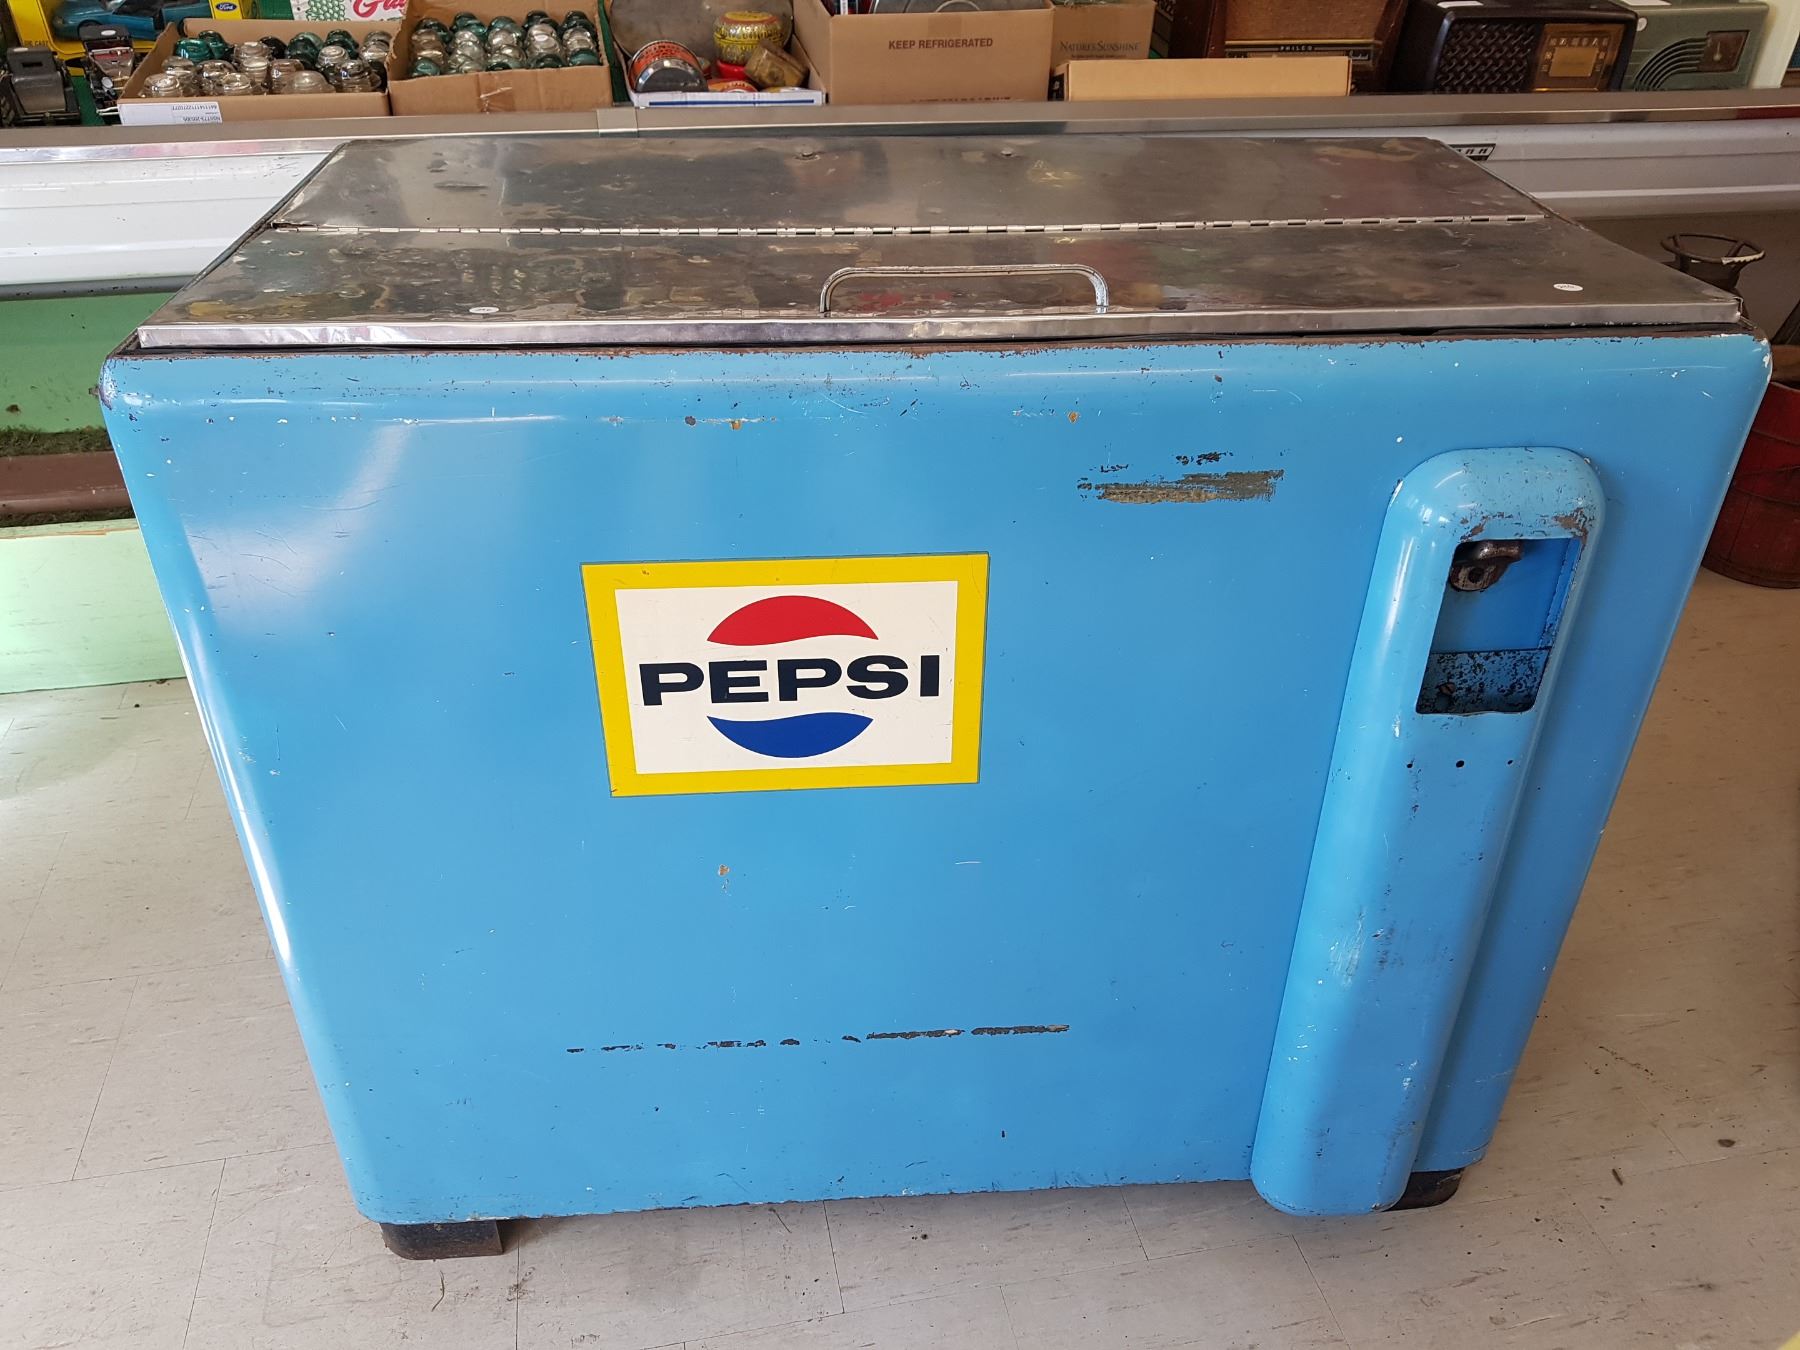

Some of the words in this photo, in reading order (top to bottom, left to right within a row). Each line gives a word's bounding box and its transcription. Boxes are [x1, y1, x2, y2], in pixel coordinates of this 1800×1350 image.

[888, 40, 916, 50] KEEP
[918, 38, 993, 49] REFRIGERATED
[639, 654, 940, 706] PEPSI
